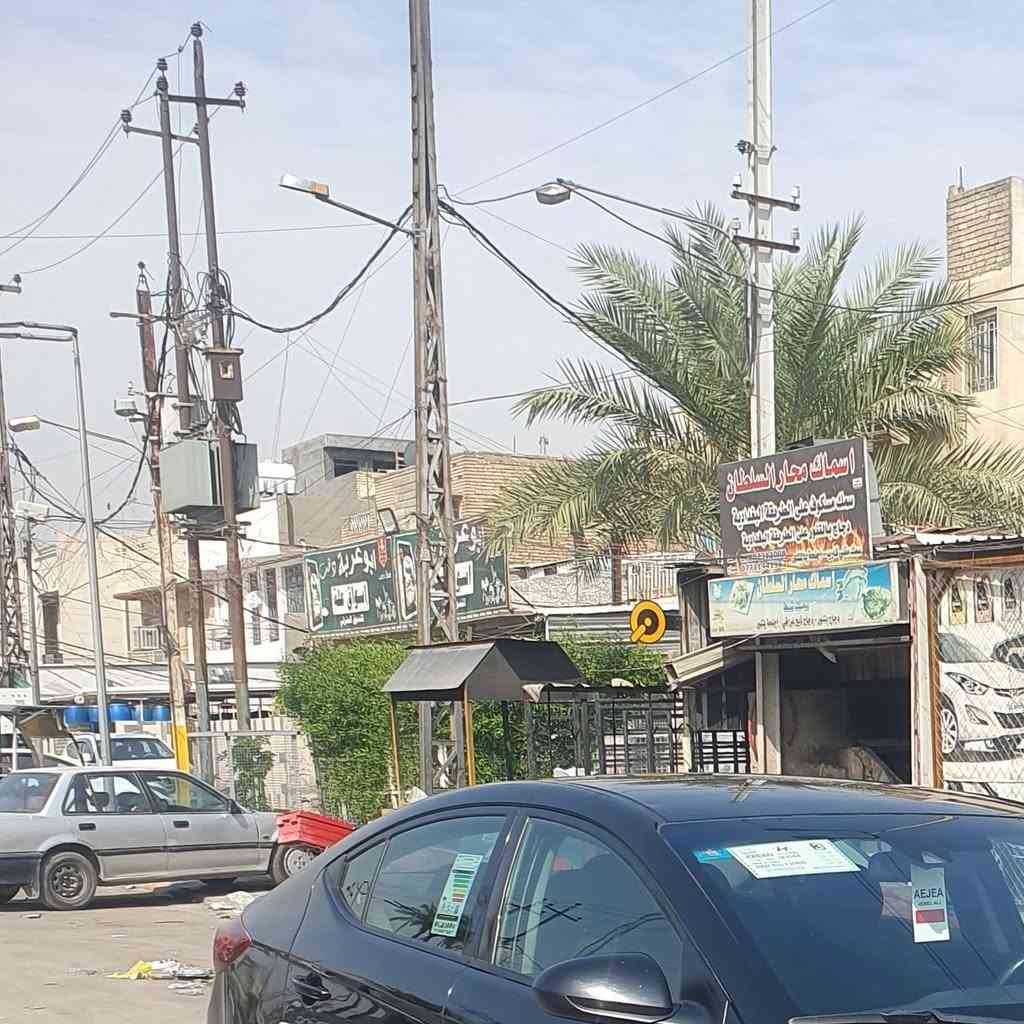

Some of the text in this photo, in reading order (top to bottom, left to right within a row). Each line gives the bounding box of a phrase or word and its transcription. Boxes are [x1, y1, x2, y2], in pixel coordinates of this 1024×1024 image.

[810, 448, 855, 481] اسماك
[726, 461, 776, 502] السلطان
[833, 520, 852, 541] دجاج
